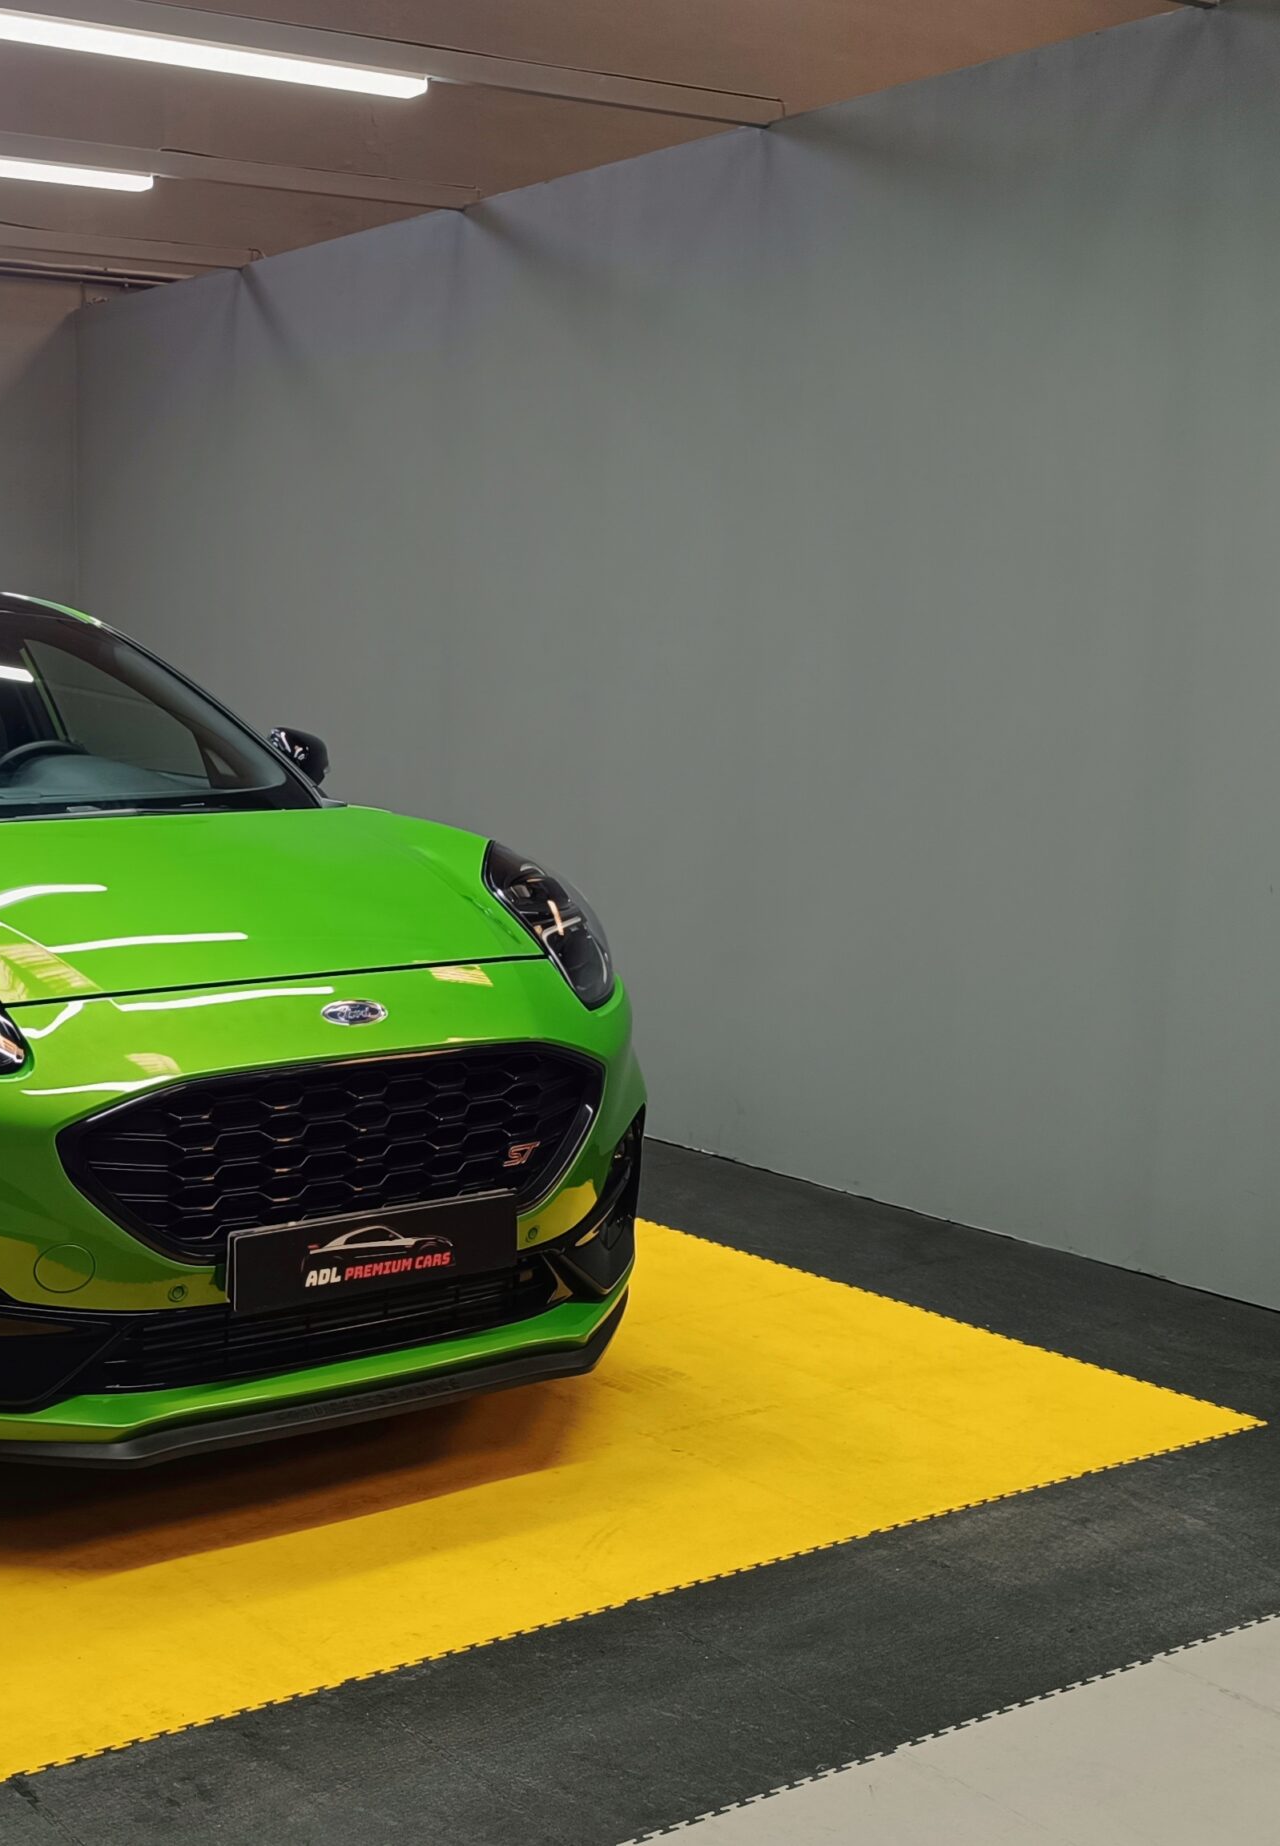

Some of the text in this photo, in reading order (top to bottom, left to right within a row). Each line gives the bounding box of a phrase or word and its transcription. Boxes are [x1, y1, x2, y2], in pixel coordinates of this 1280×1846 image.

[334, 1004, 375, 1021] Ford
[503, 1140, 541, 1168] ST
[305, 1251, 452, 1288] ADL PREMIUM CARS
